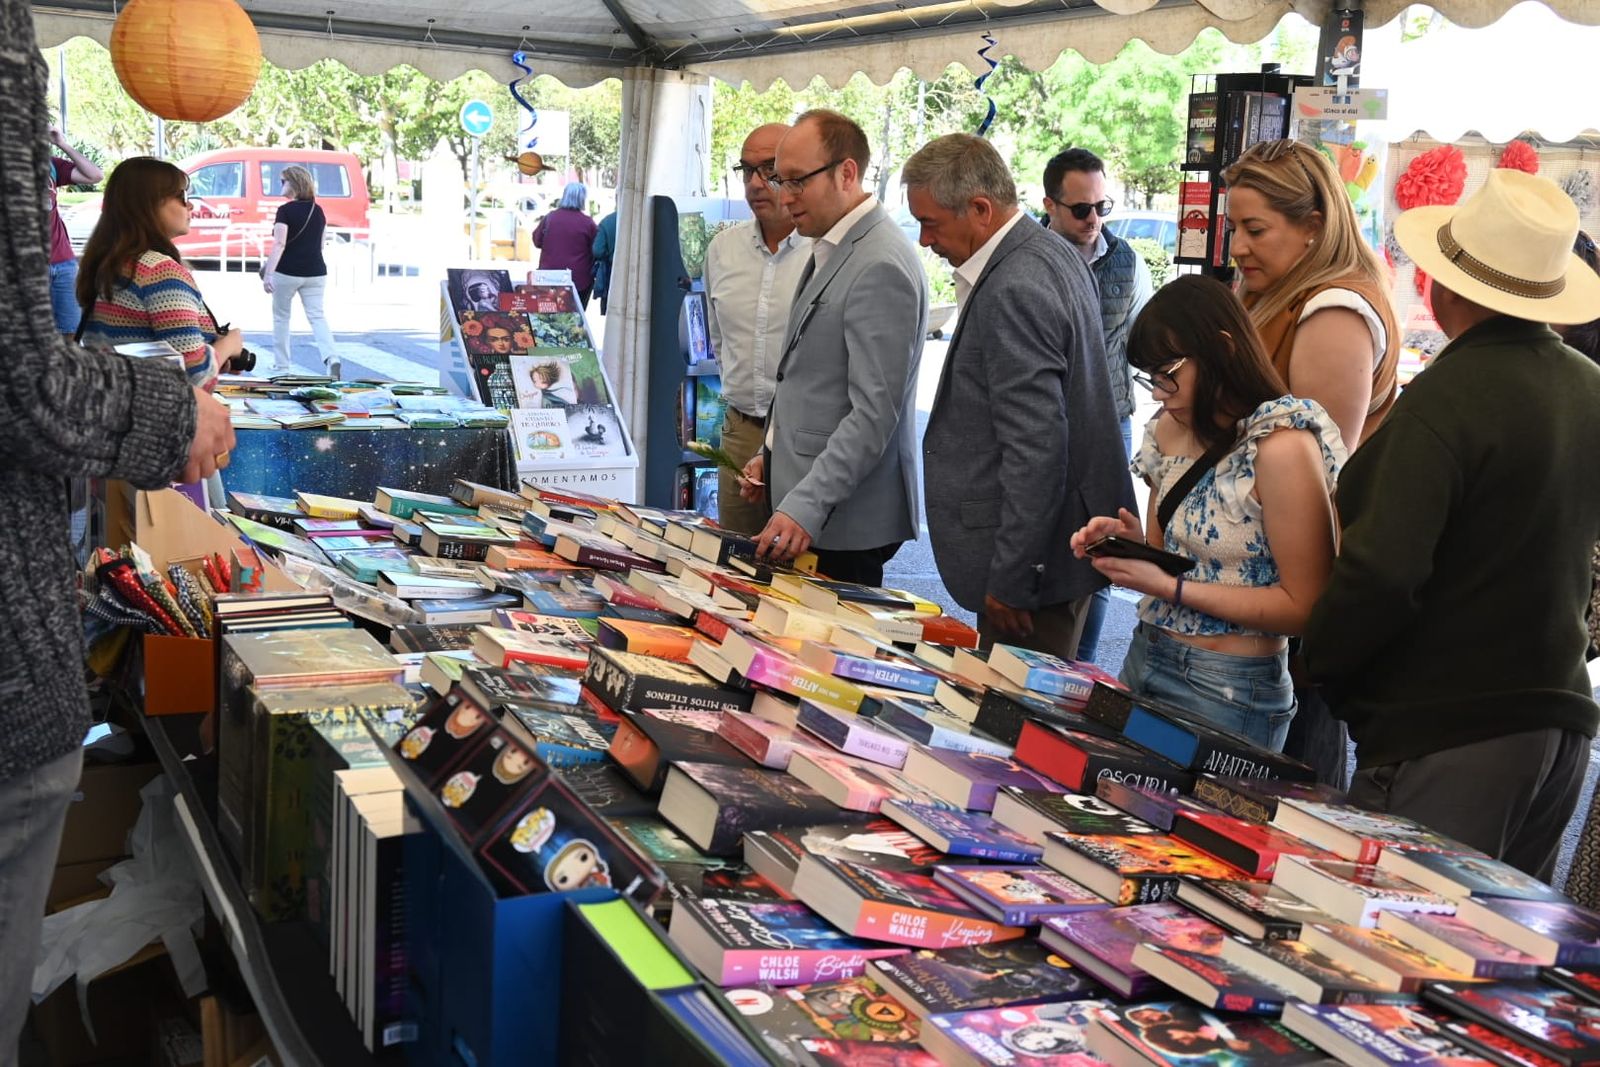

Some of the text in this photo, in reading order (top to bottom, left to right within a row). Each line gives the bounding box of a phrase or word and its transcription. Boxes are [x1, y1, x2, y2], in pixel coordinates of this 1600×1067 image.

[875, 669, 901, 683] AFTER
[791, 674, 819, 693] AFTER
[645, 690, 688, 704] ETERNOS
[690, 698, 719, 709] MITOS
[722, 702, 739, 712] LOS
[1203, 750, 1270, 779] ANATEMA
[891, 911, 928, 928] CHLOE
[888, 923, 925, 939] WALSH
[941, 918, 993, 949] Keeping
[760, 956, 799, 969] CHLOE
[758, 968, 798, 980] WALSH
